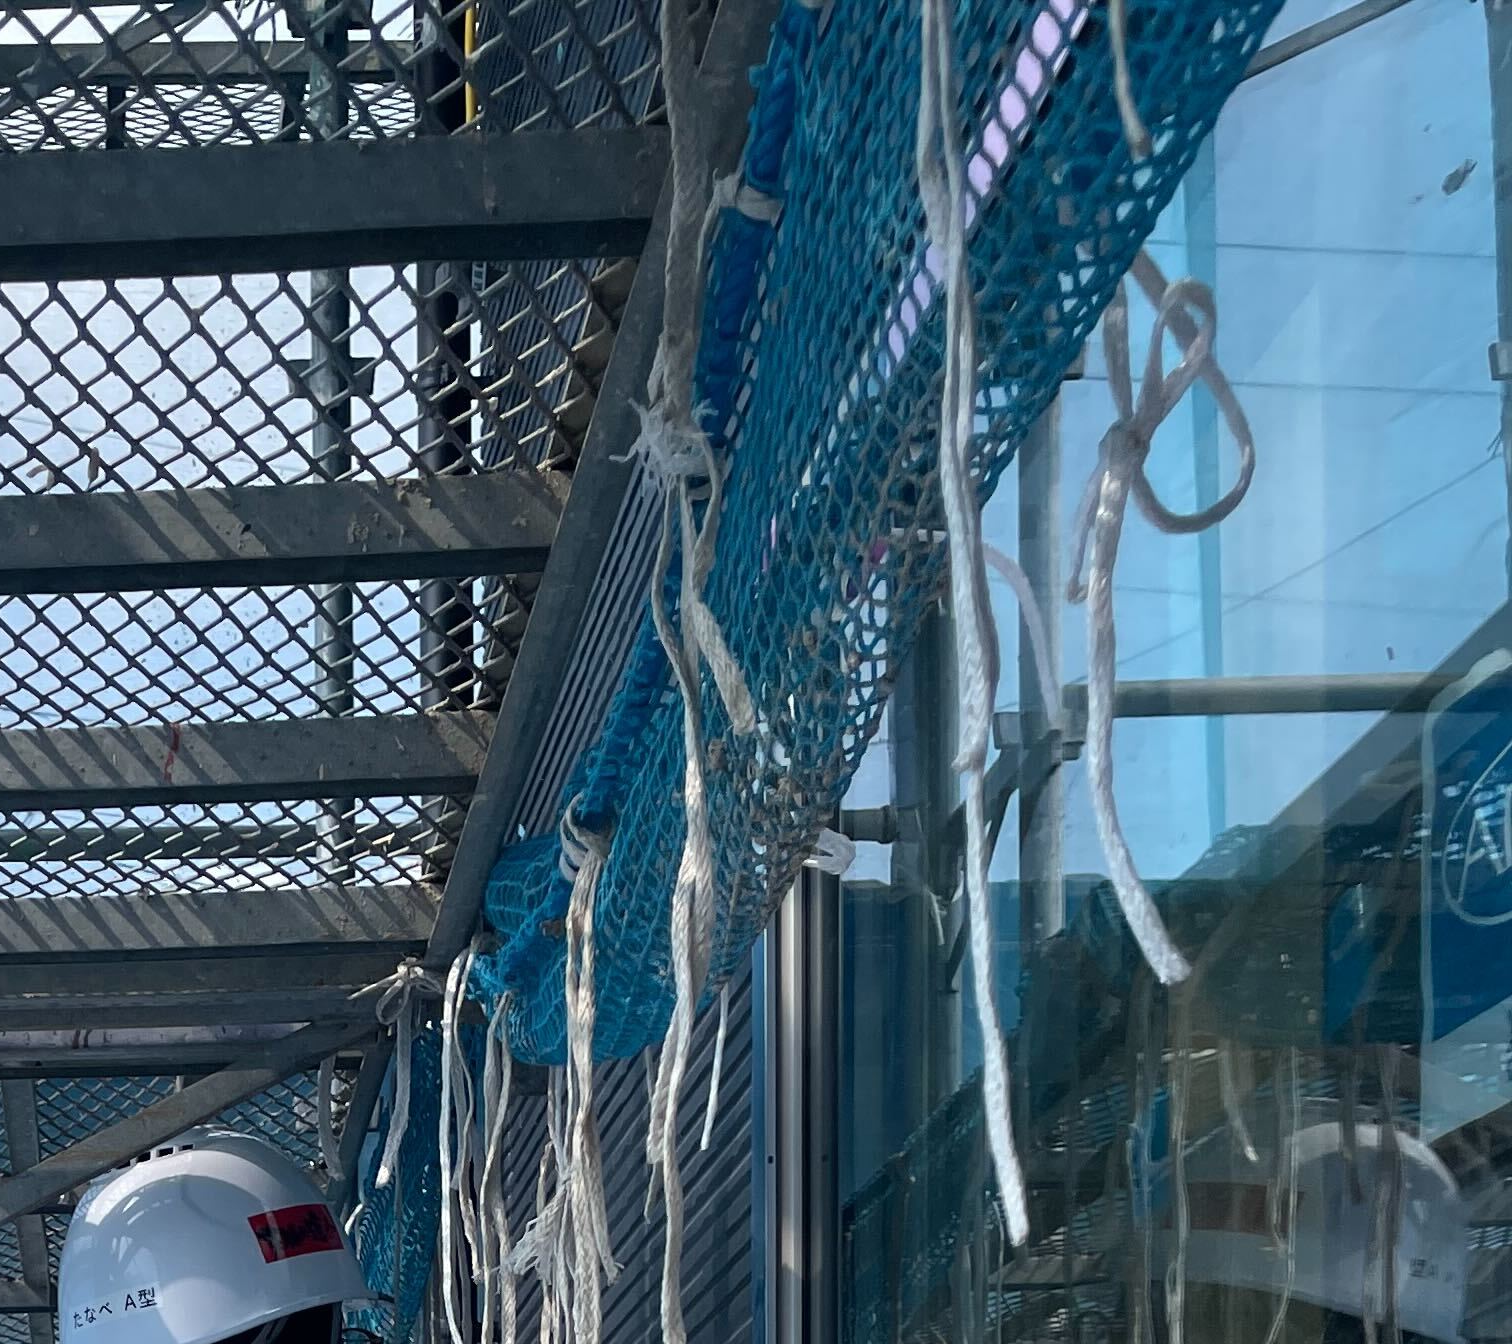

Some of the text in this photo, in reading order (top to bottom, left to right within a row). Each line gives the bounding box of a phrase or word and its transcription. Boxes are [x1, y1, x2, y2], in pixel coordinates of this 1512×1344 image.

[73, 1287, 158, 1329] たなべ A型
